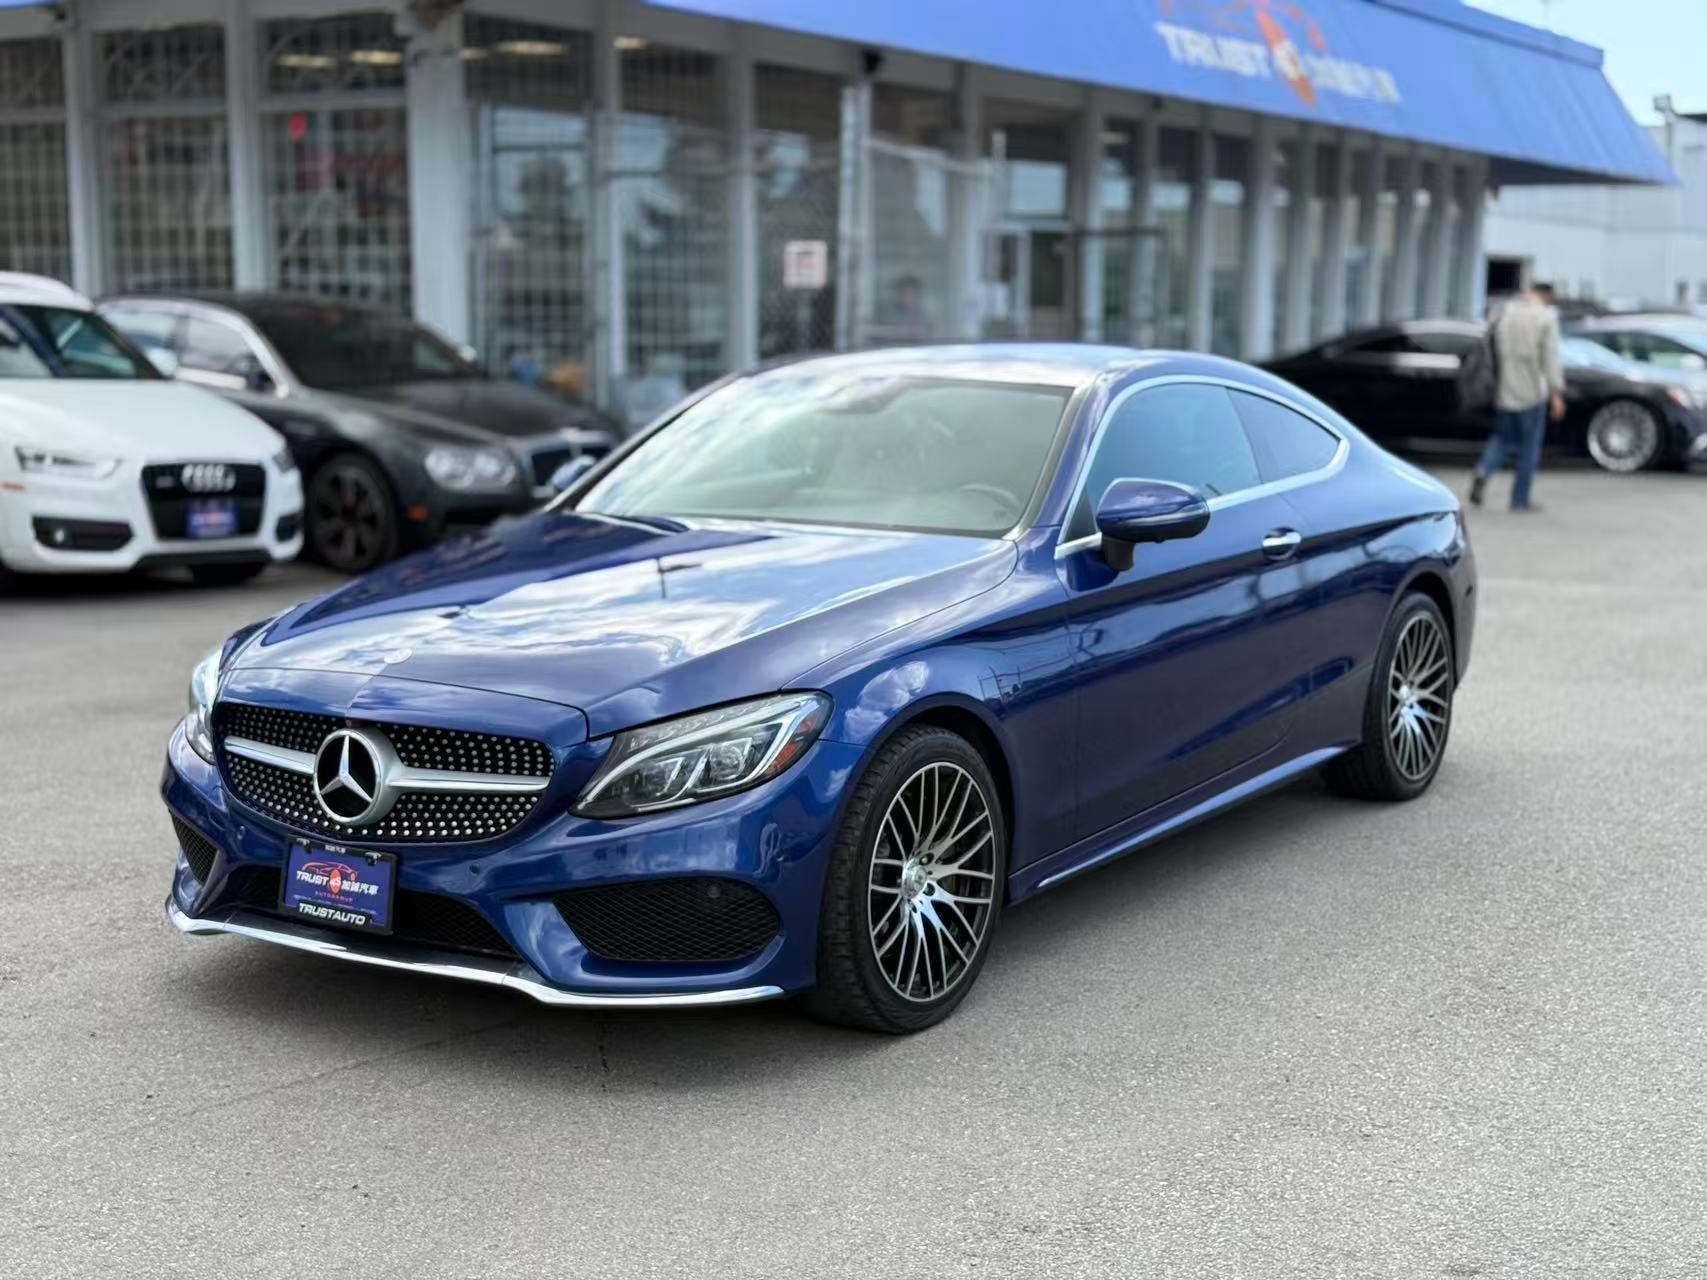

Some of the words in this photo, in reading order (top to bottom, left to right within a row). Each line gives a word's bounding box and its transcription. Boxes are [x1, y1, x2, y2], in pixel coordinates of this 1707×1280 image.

[1153, 20, 1270, 80] TRUST
[296, 870, 329, 886] TRUST
[299, 903, 366, 925] TRUSTAUTO
